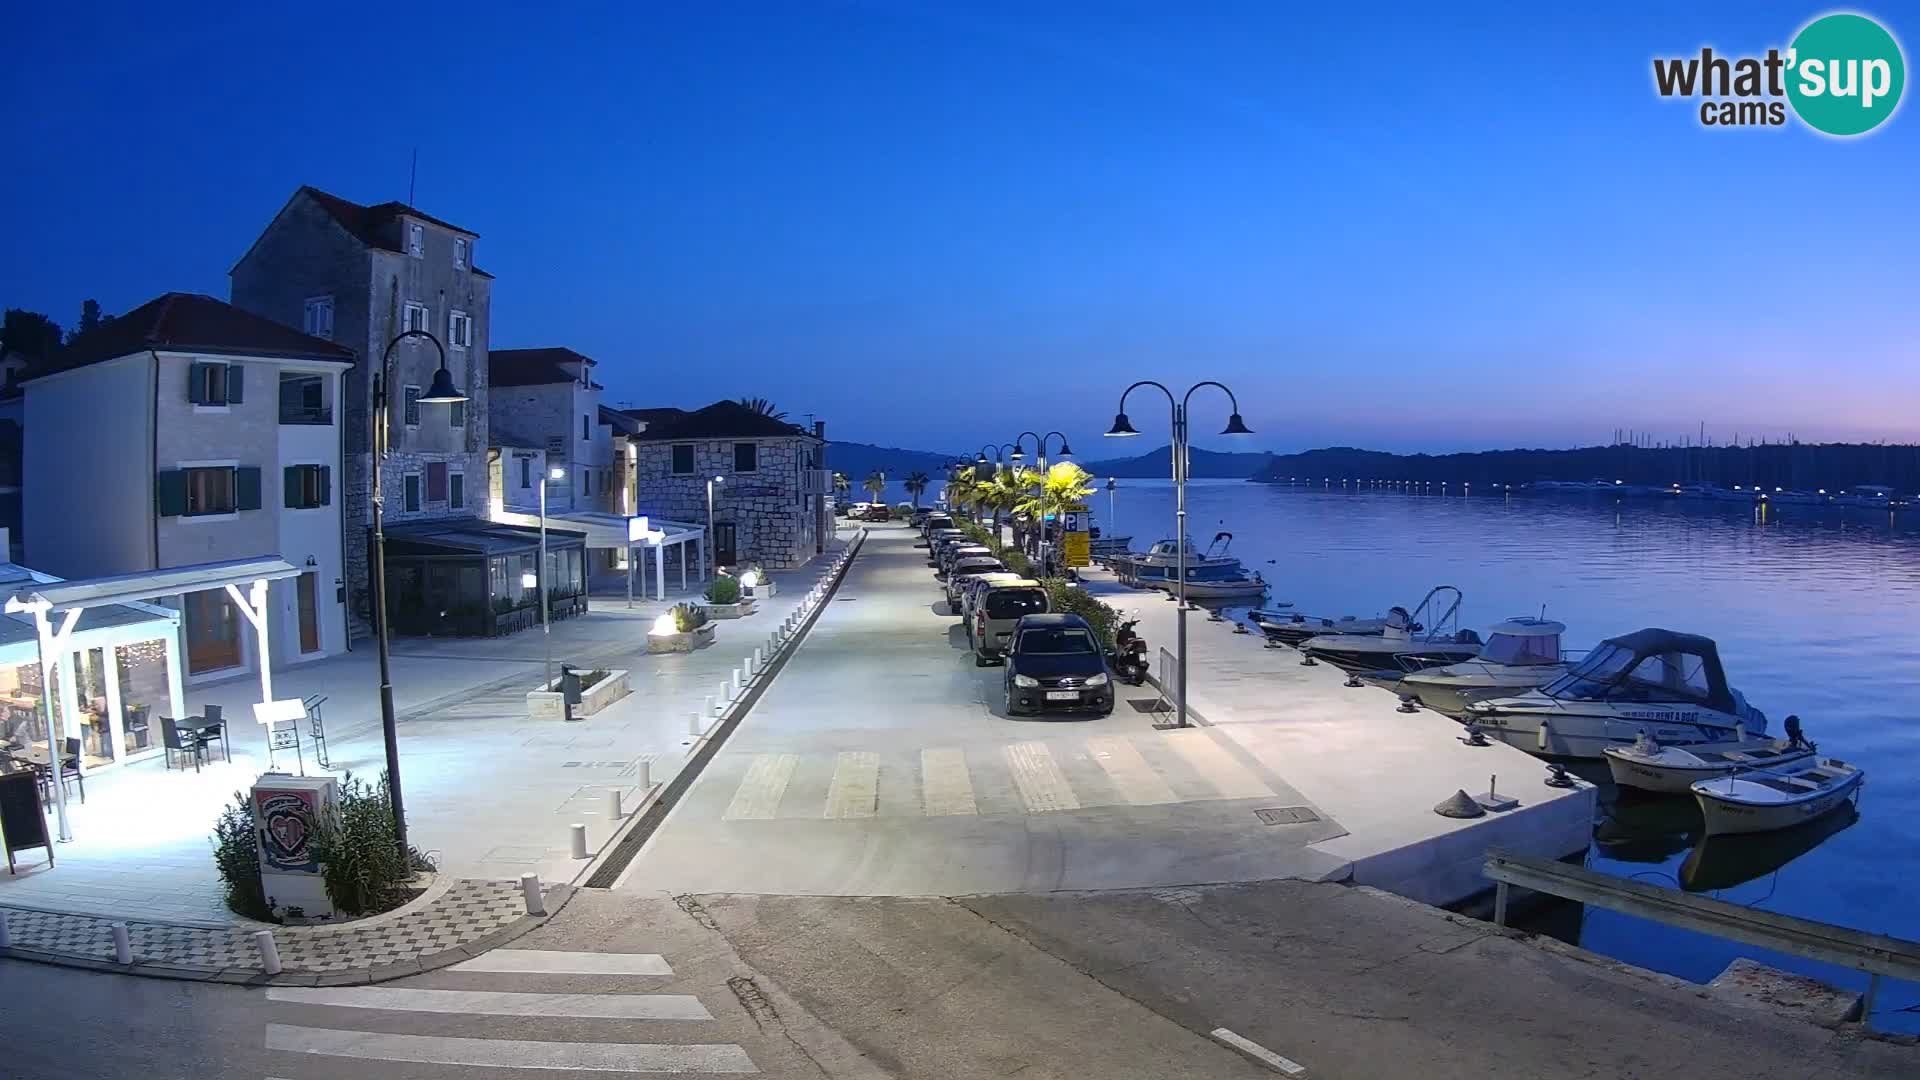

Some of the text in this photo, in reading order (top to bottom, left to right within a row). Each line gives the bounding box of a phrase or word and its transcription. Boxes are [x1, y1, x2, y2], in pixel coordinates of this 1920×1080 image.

[1066, 514, 1077, 530] P
[1655, 711, 1674, 720] RENT
[1675, 711, 1680, 720] A
[1681, 711, 1699, 722] BOAT
